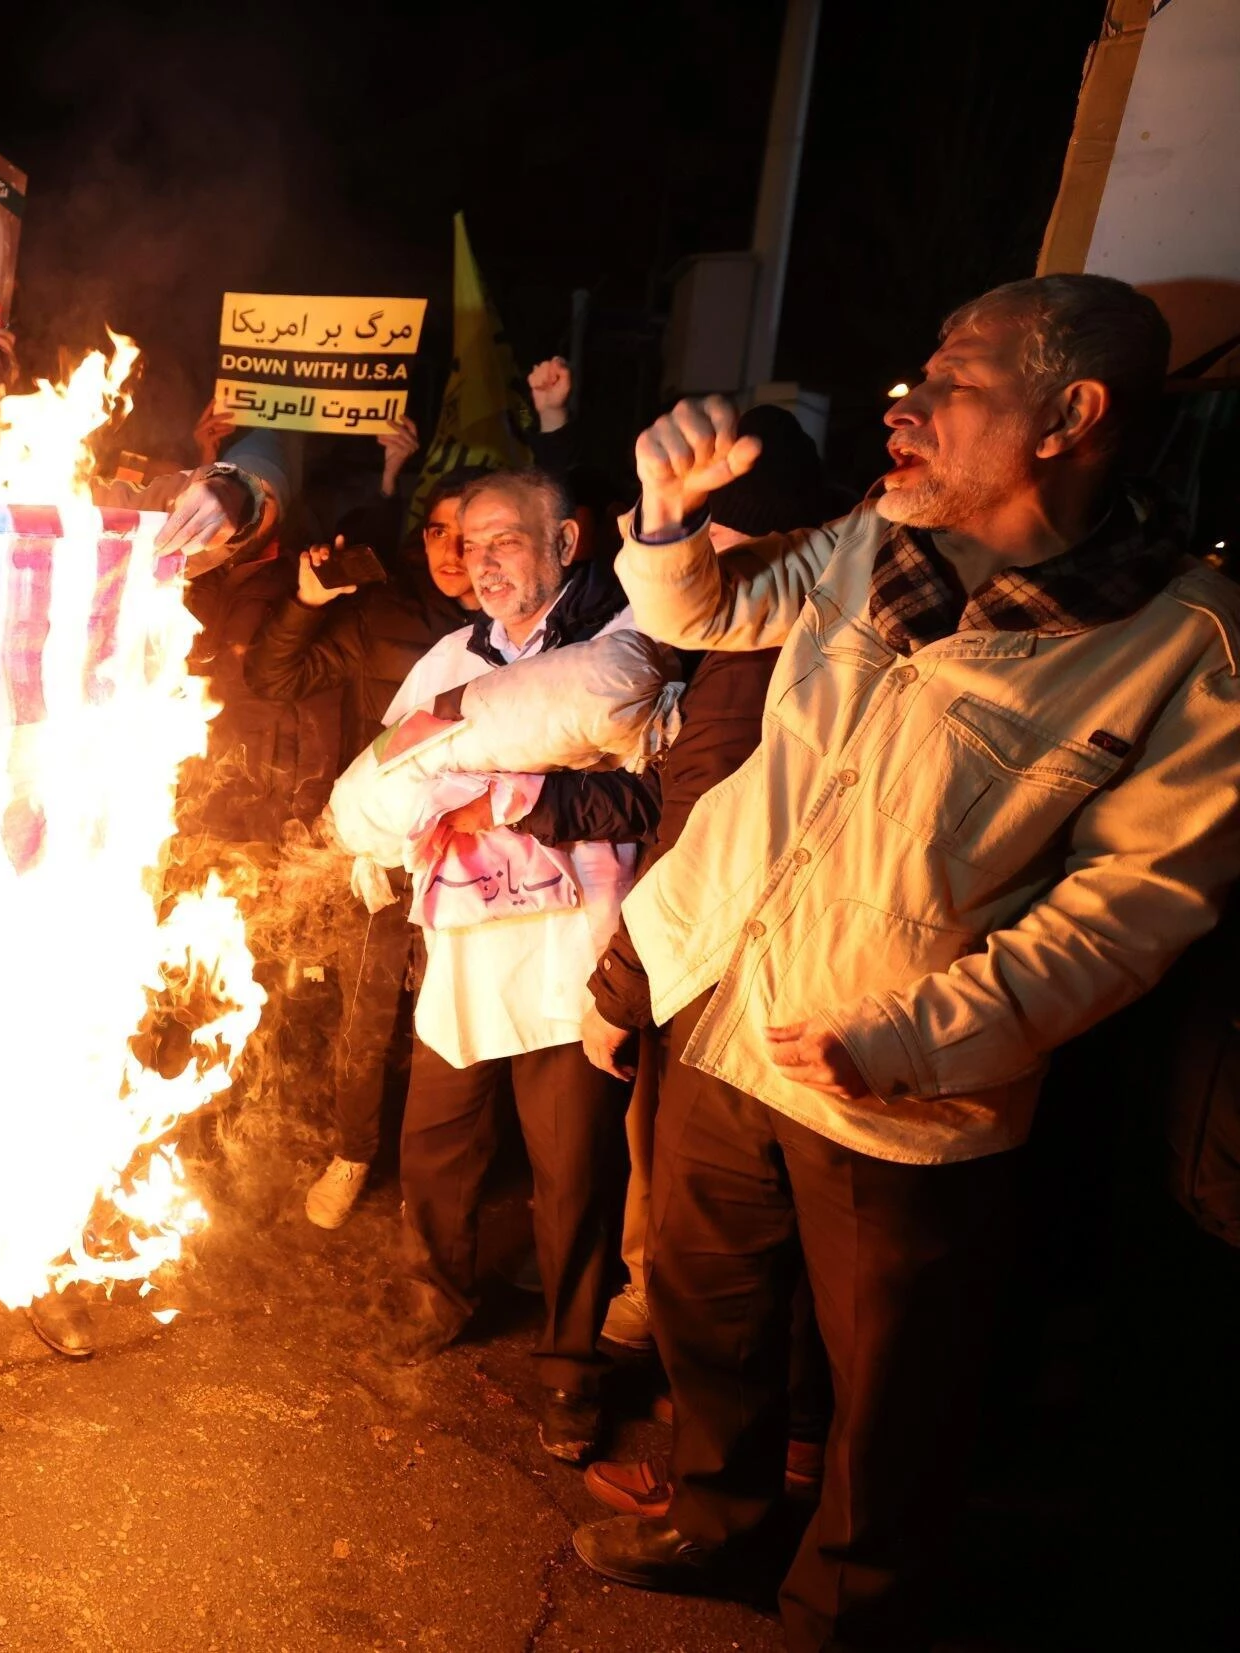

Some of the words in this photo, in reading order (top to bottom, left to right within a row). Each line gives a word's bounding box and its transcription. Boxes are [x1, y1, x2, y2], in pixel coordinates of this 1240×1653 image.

[316, 321, 343, 348] بر
[355, 309, 413, 348] مرگ
[221, 353, 288, 376] DOWN
[293, 360, 348, 379] WITH
[353, 362, 408, 380] U.S.A
[321, 398, 399, 427] الموت
